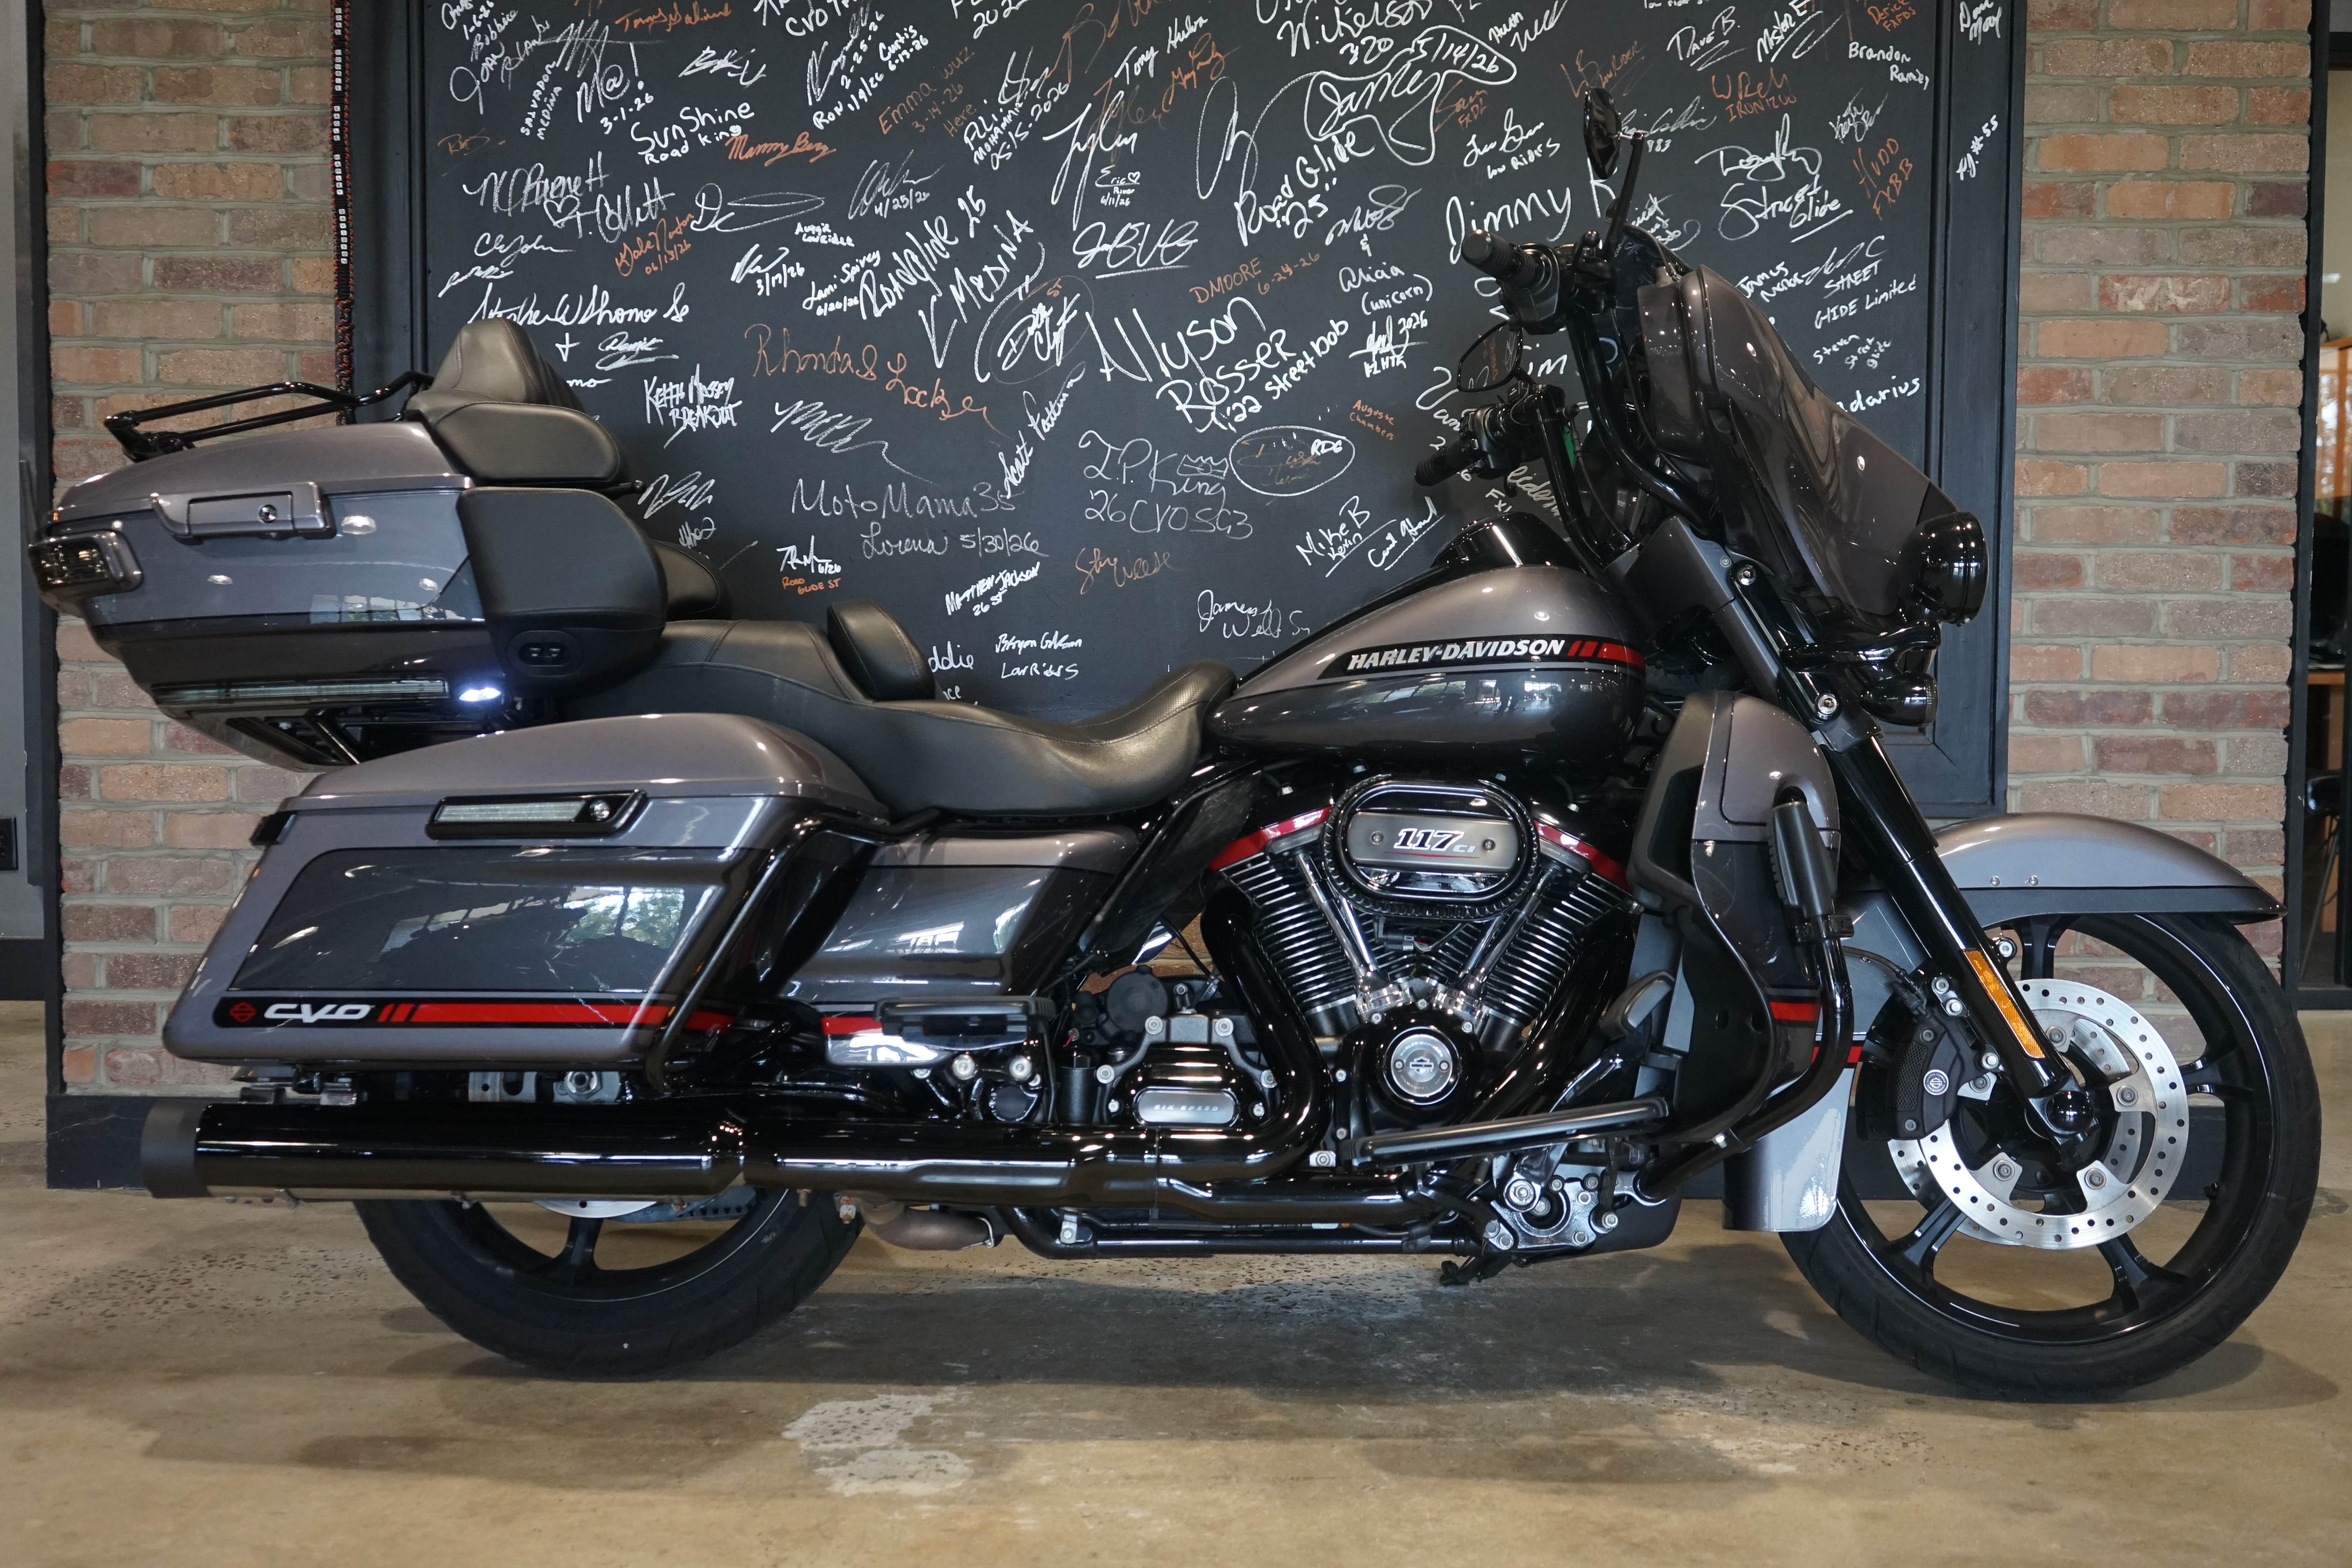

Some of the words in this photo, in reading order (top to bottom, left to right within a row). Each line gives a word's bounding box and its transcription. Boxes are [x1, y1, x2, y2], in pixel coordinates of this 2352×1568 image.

[879, 25, 918, 62] Curtis
[1848, 42, 1911, 63] Brandon
[680, 102, 755, 132] Shine
[878, 82, 937, 135] Emma
[334, 154, 343, 195] HARLEY
[339, 209, 348, 264] DAVIDSON
[927, 641, 975, 673] ddie
[1347, 639, 1566, 671] HARLEY-DAVIDSON
[1393, 828, 1465, 852] 117
[263, 1004, 371, 1024] CVO
